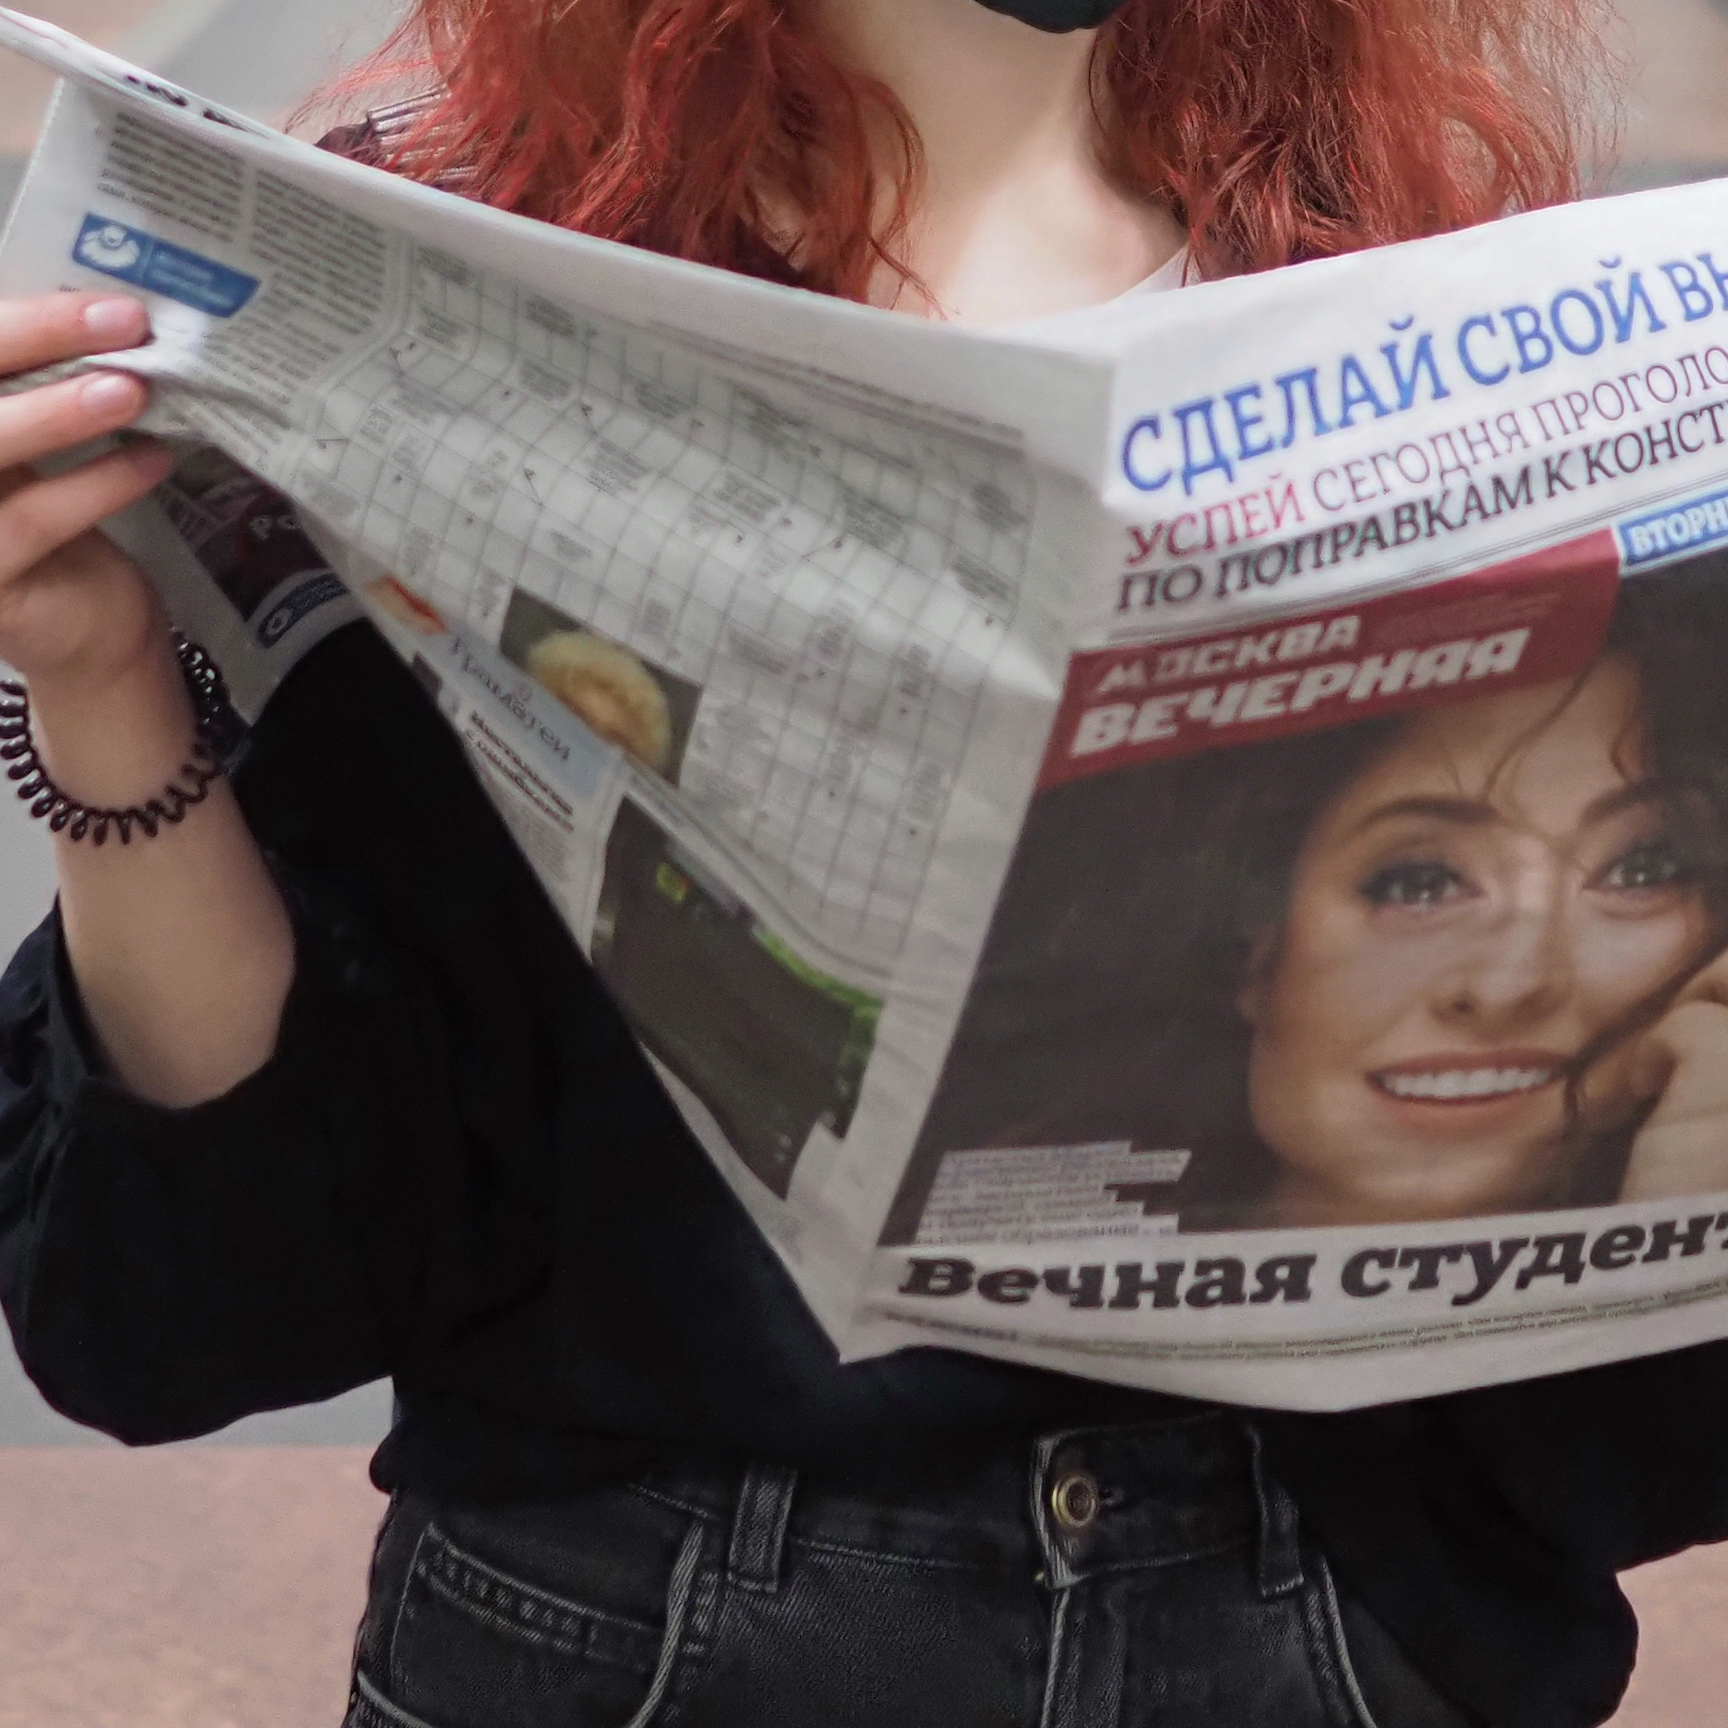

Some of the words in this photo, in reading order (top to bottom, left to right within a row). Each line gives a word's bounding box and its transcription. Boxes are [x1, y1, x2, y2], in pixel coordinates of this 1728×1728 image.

[1122, 315, 1450, 495] СДЕЛАЙ
[1457, 256, 1667, 386] СВОЙ
[1117, 566, 1203, 610] ПО
[1215, 476, 1535, 598] ПОПРАВКАМ
[1545, 456, 1577, 499] К
[1125, 473, 1305, 565] УСПЕЙ
[1313, 412, 1529, 511] СЕГОДНЯ
[1071, 628, 1531, 758] ВЕЧЕРНЯЯ
[1094, 615, 1360, 696] МОСКВА
[898, 1253, 1317, 1309] Вечная
